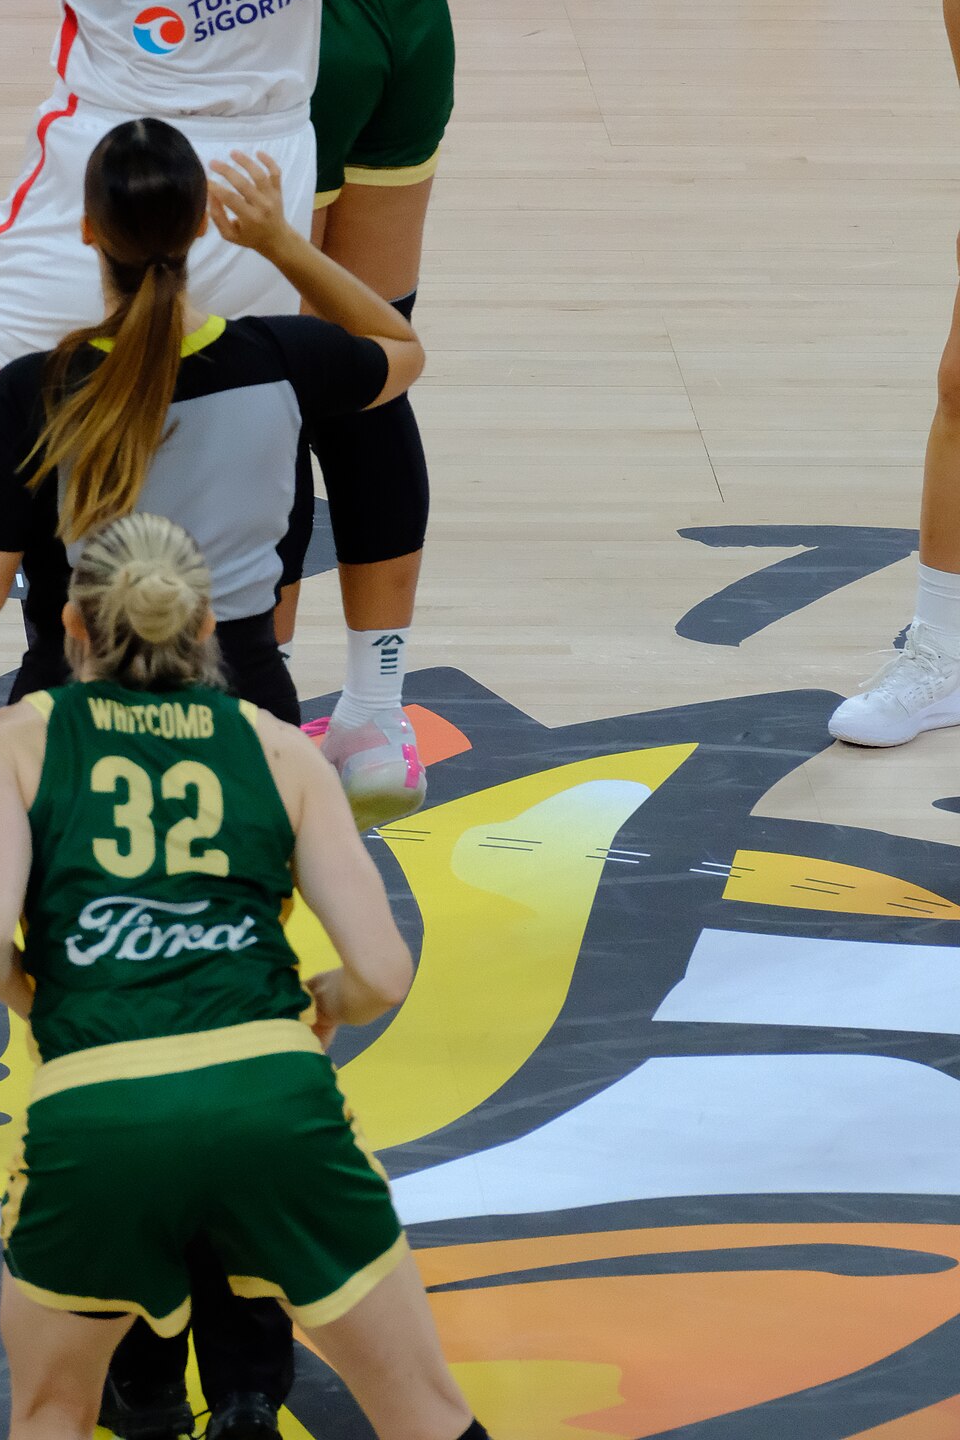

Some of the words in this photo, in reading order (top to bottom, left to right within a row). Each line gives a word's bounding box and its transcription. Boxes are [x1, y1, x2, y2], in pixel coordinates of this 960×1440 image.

[87, 697, 214, 740] WHITCOMB
[90, 755, 230, 879] 32
[65, 895, 258, 966] Ford
